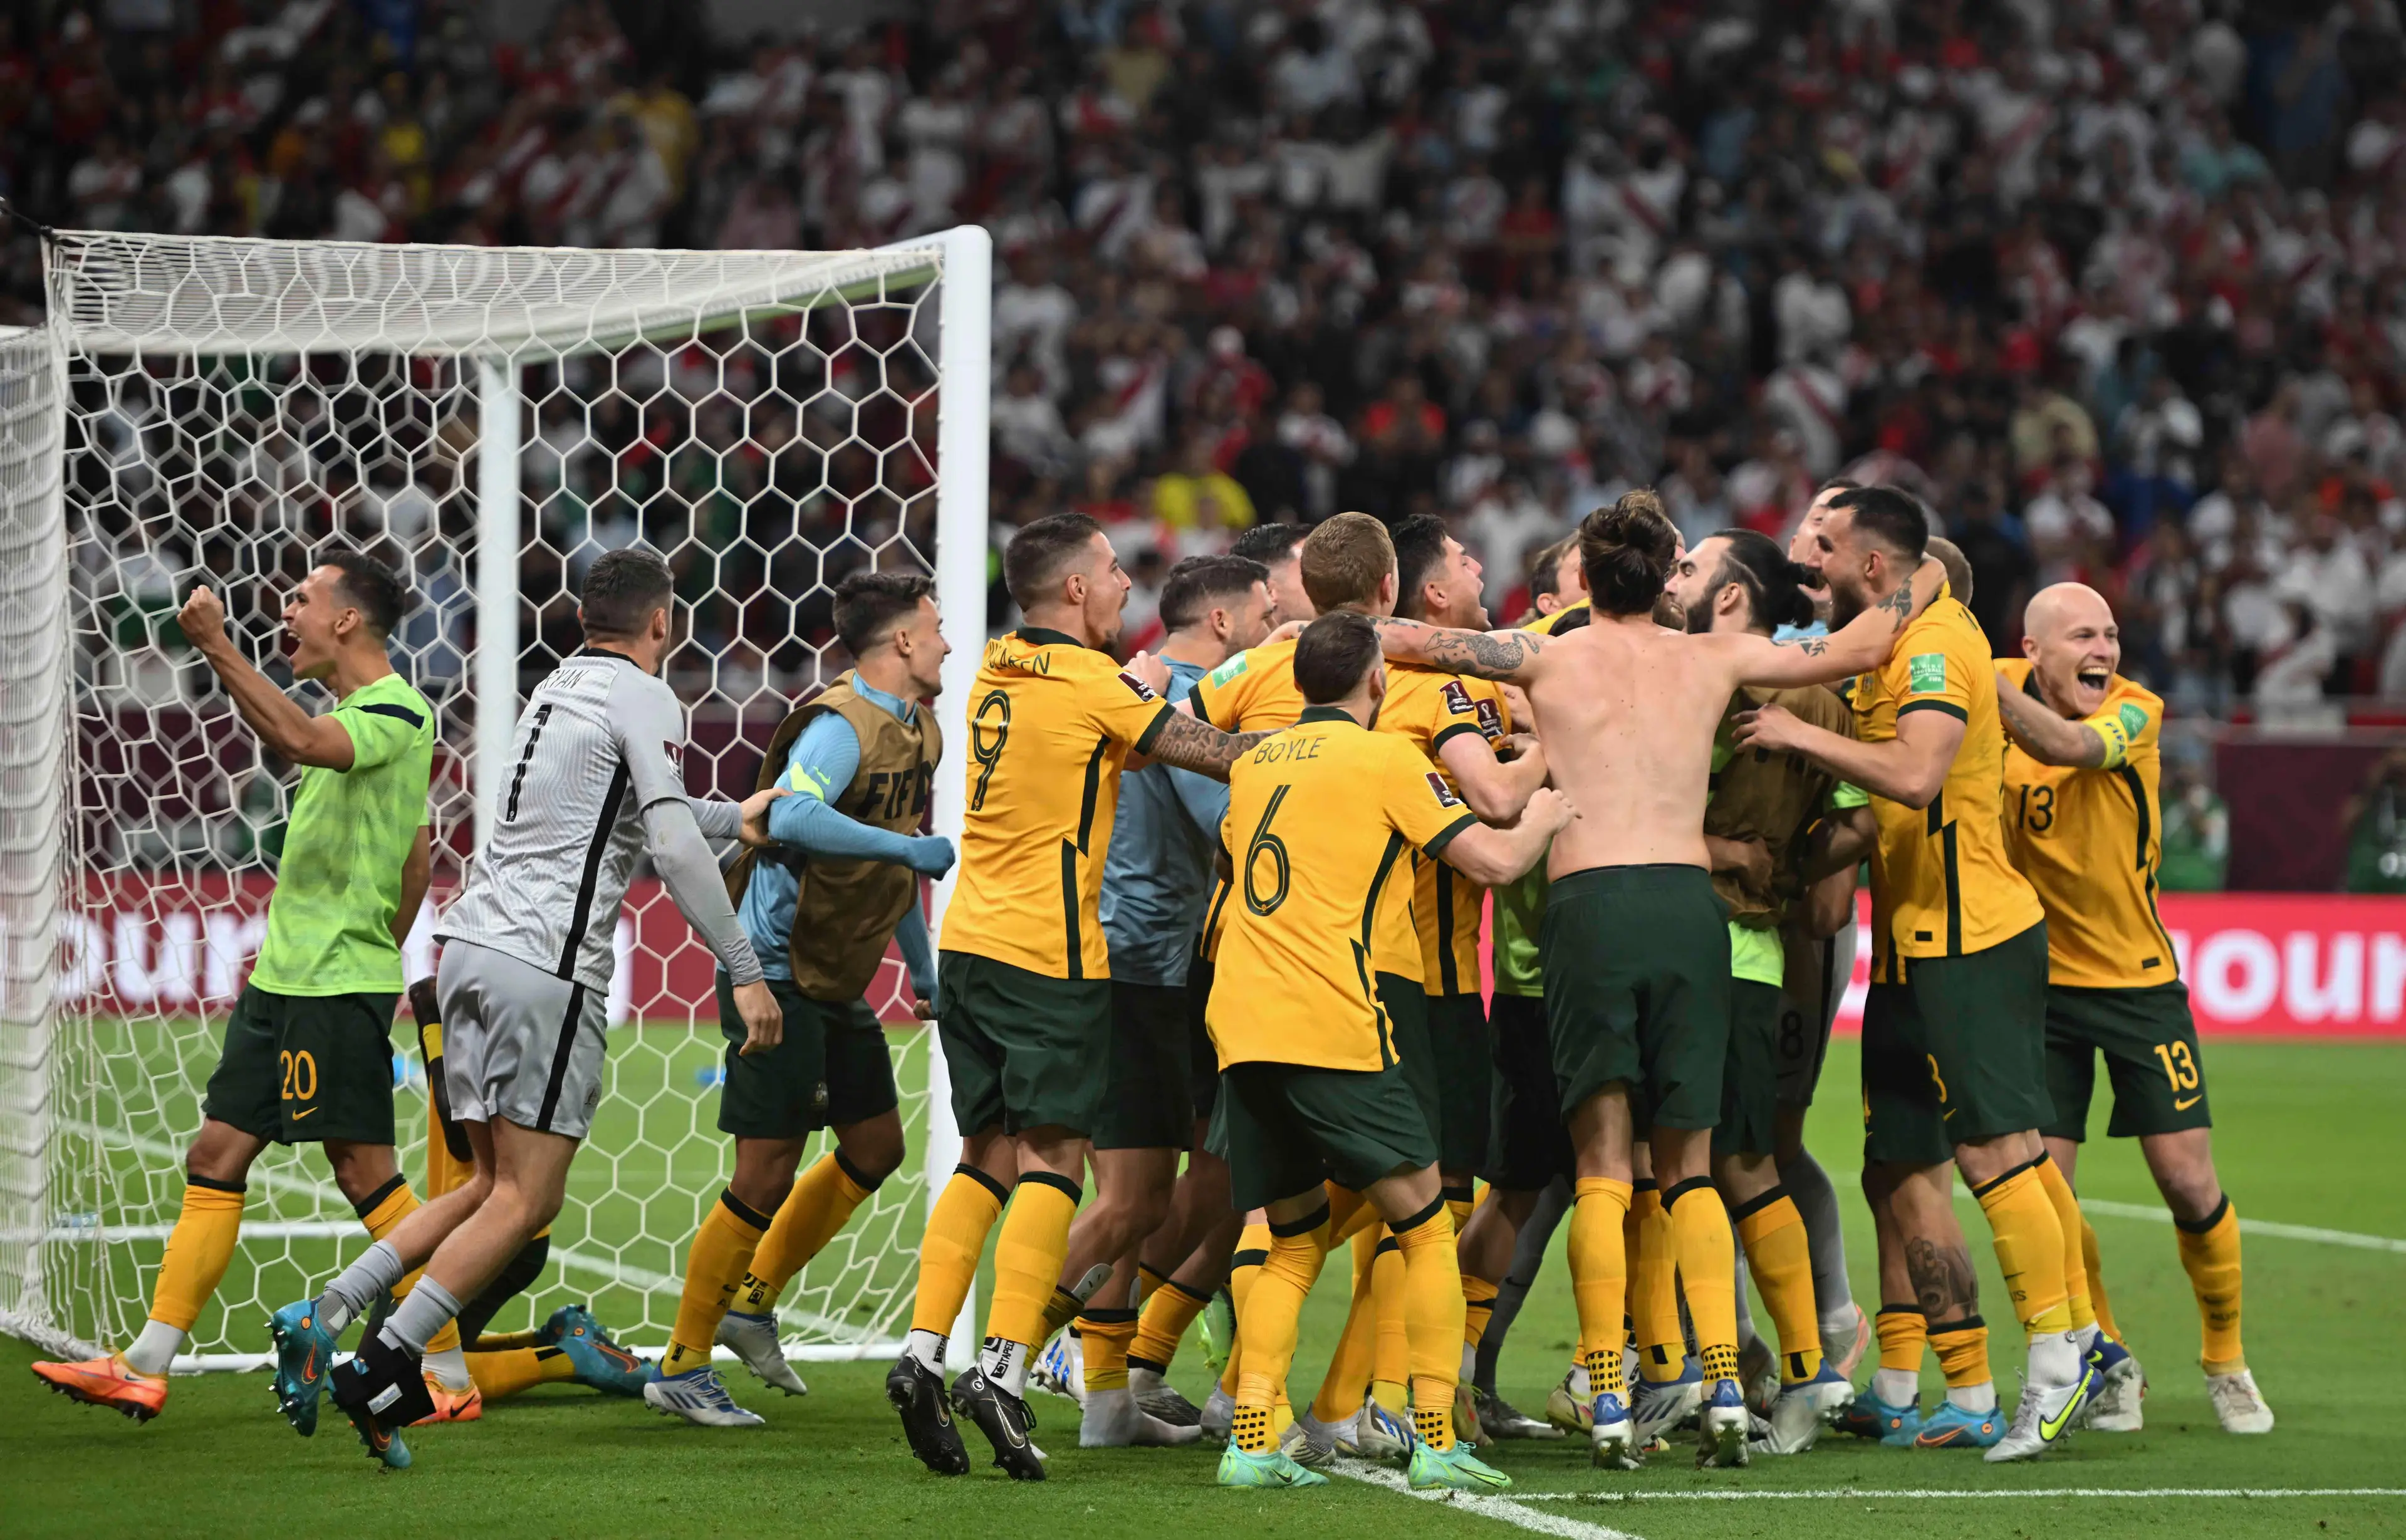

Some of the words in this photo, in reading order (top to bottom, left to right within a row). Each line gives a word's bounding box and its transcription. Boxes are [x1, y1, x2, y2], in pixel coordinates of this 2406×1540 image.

[539, 669, 590, 690] RYAN
[506, 704, 552, 822] 1
[971, 689, 1011, 811] 9
[1253, 737, 1328, 764] BOYLE
[2018, 784, 2054, 832] 13
[1244, 784, 1291, 917] 6
[280, 1049, 317, 1100] 20
[2153, 1040, 2199, 1093] 13
[1000, 1340, 1016, 1363] TAPED
